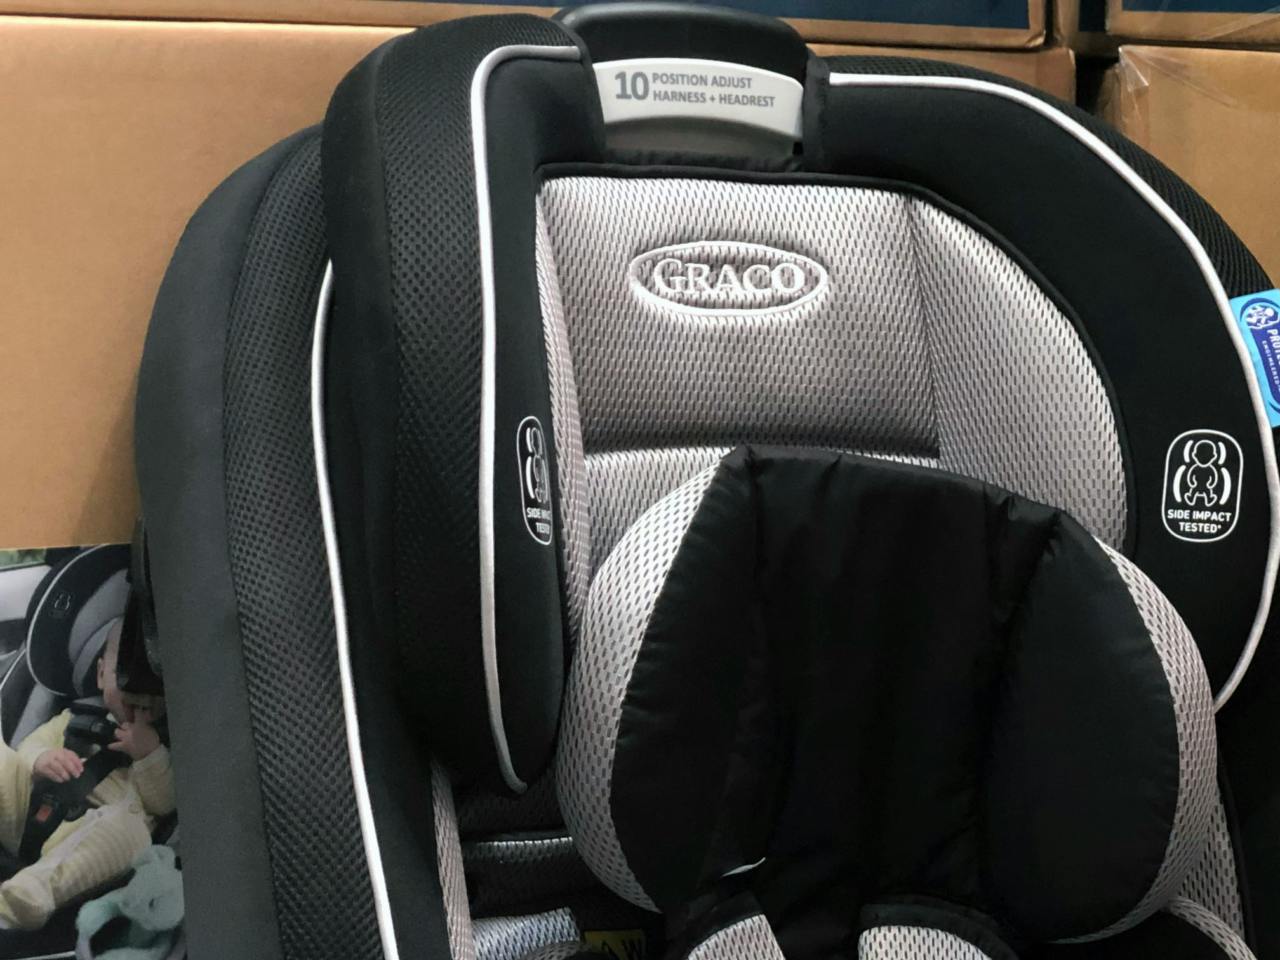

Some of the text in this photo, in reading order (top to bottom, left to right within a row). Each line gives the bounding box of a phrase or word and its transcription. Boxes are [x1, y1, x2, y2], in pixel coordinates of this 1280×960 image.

[615, 72, 649, 100] 10
[652, 73, 752, 89] POSITION ADJUST
[653, 91, 706, 104] HARNESS
[719, 94, 775, 108] HEADREST
[653, 258, 805, 294] GRACO
[1167, 509, 1232, 522] SIDE IMPACT
